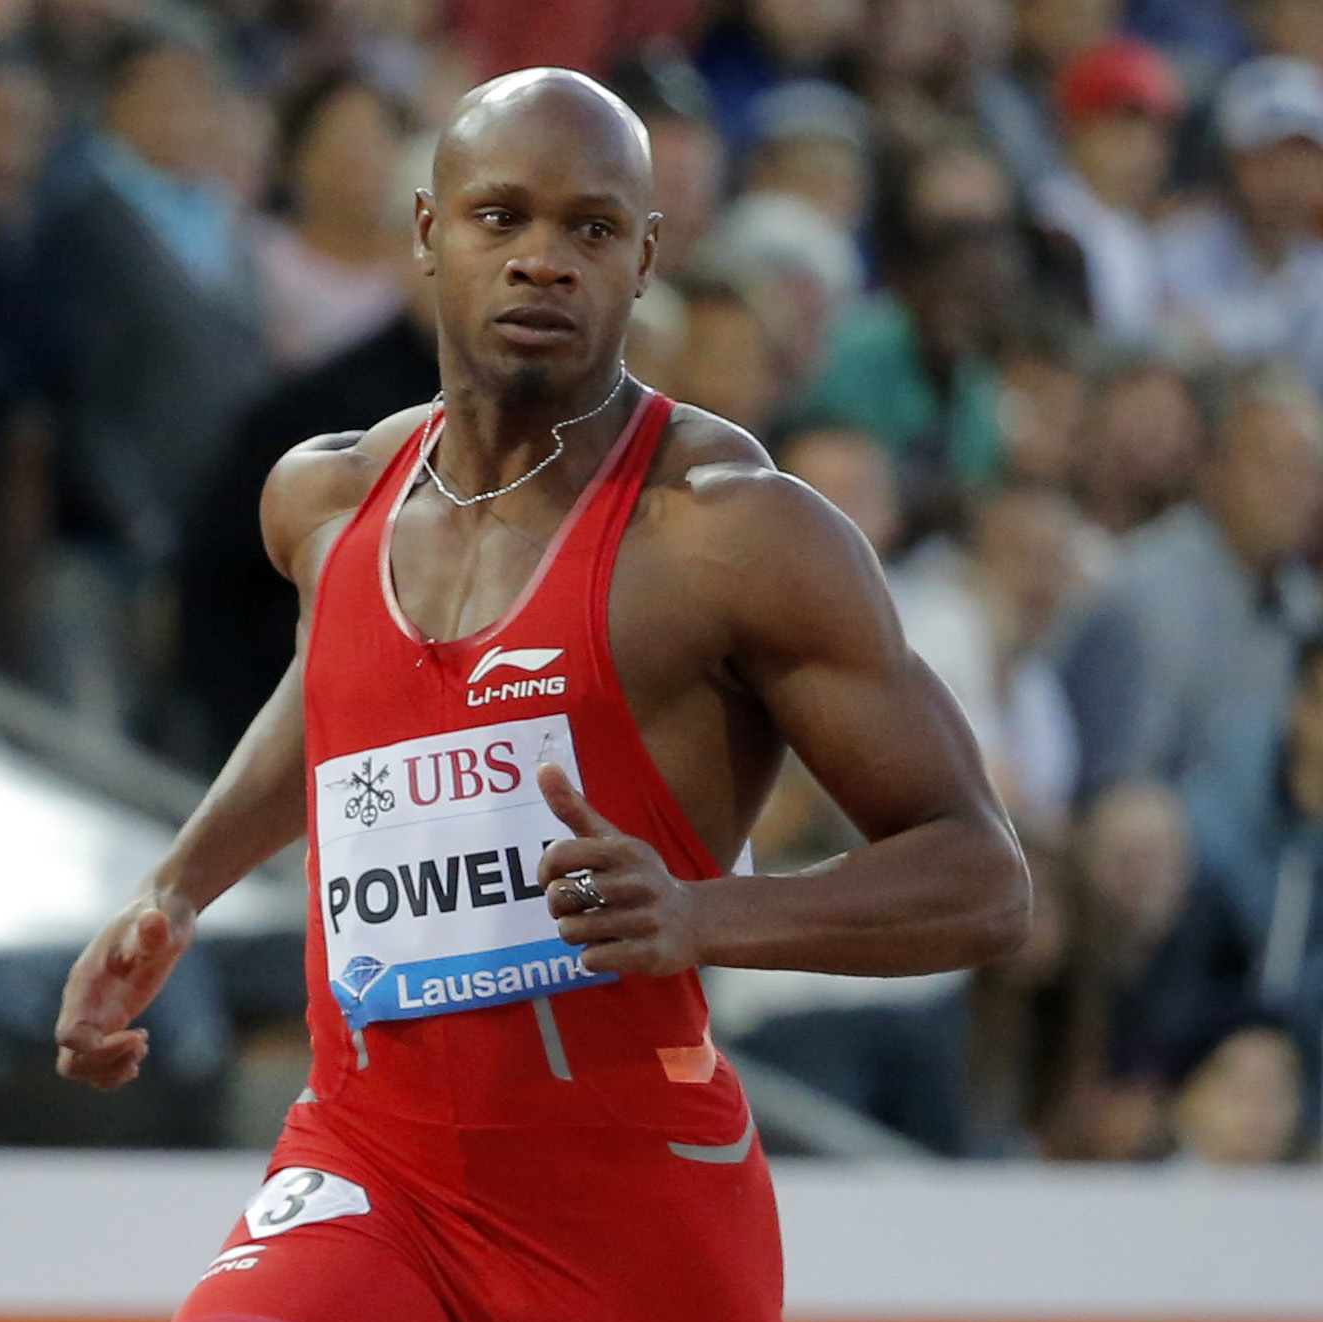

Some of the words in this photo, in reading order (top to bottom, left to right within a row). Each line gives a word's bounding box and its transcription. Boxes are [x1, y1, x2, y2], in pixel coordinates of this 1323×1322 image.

[466, 676, 567, 707] LI-NING
[403, 741, 522, 807] UBS
[328, 838, 557, 934] POWEL
[258, 1171, 325, 1227] 3
